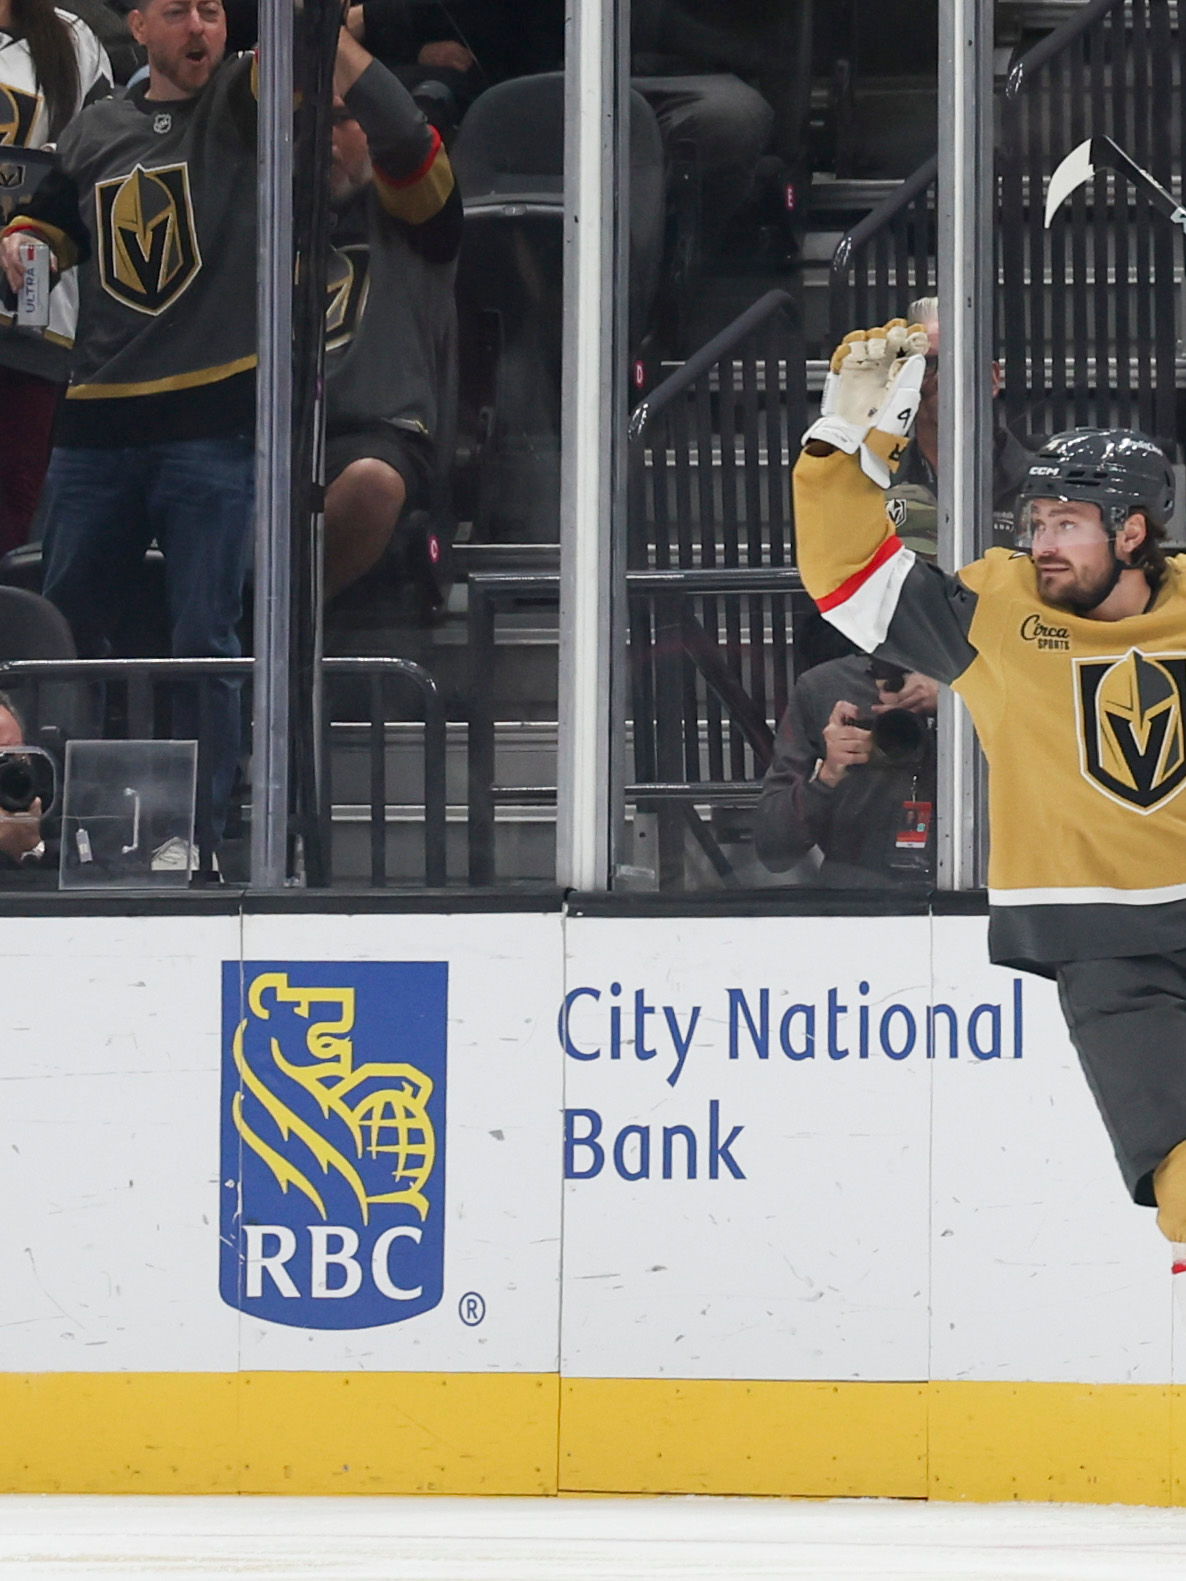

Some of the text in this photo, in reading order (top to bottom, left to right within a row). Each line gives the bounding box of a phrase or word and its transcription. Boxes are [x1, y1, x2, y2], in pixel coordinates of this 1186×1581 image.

[26, 267, 37, 314] ULTRA
[1028, 466, 1060, 476] CCM
[1020, 614, 1070, 641] Circa
[1037, 638, 1070, 651] SPORTS
[558, 978, 1023, 1088] City National
[562, 1099, 746, 1182] Bank
[242, 1224, 424, 1301] RBC
